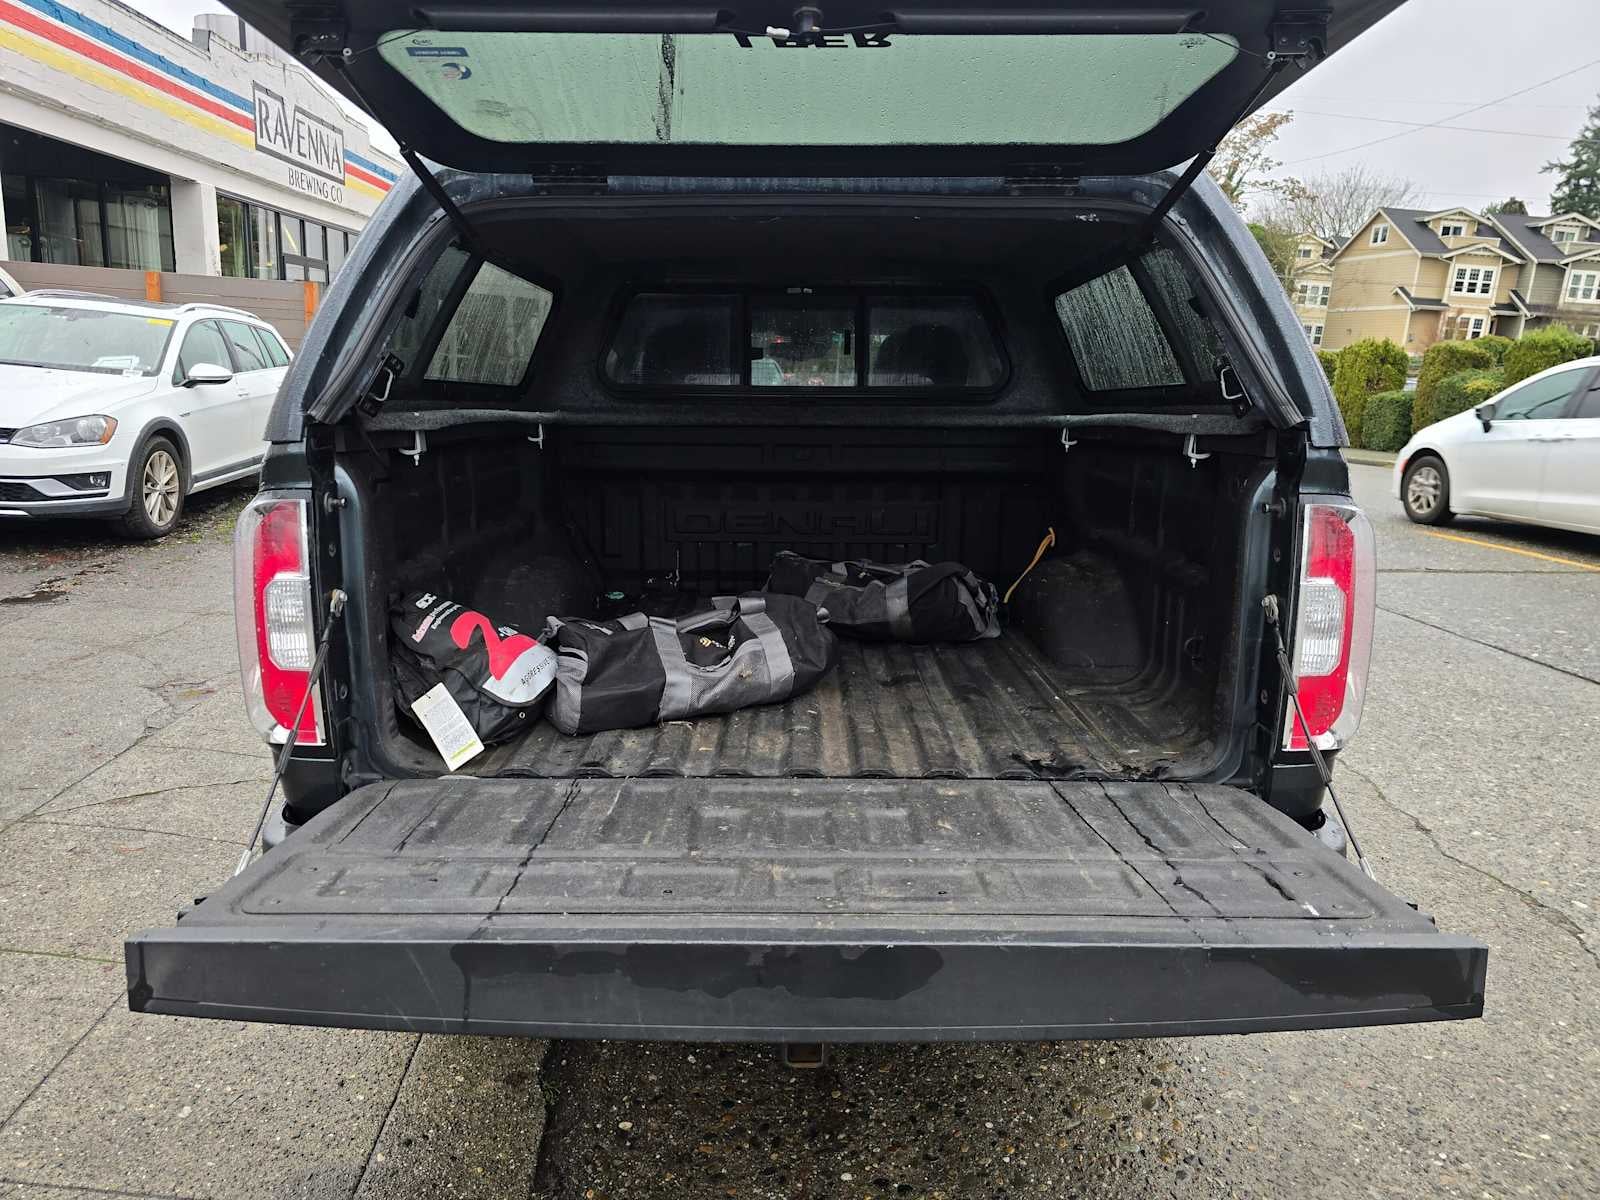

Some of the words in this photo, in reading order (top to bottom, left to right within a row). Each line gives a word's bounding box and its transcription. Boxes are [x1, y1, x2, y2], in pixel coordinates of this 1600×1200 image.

[257, 97, 342, 174] RAVENNA
[288, 167, 329, 199] BREWING
[331, 185, 343, 204] CO
[673, 507, 931, 536] DENALI
